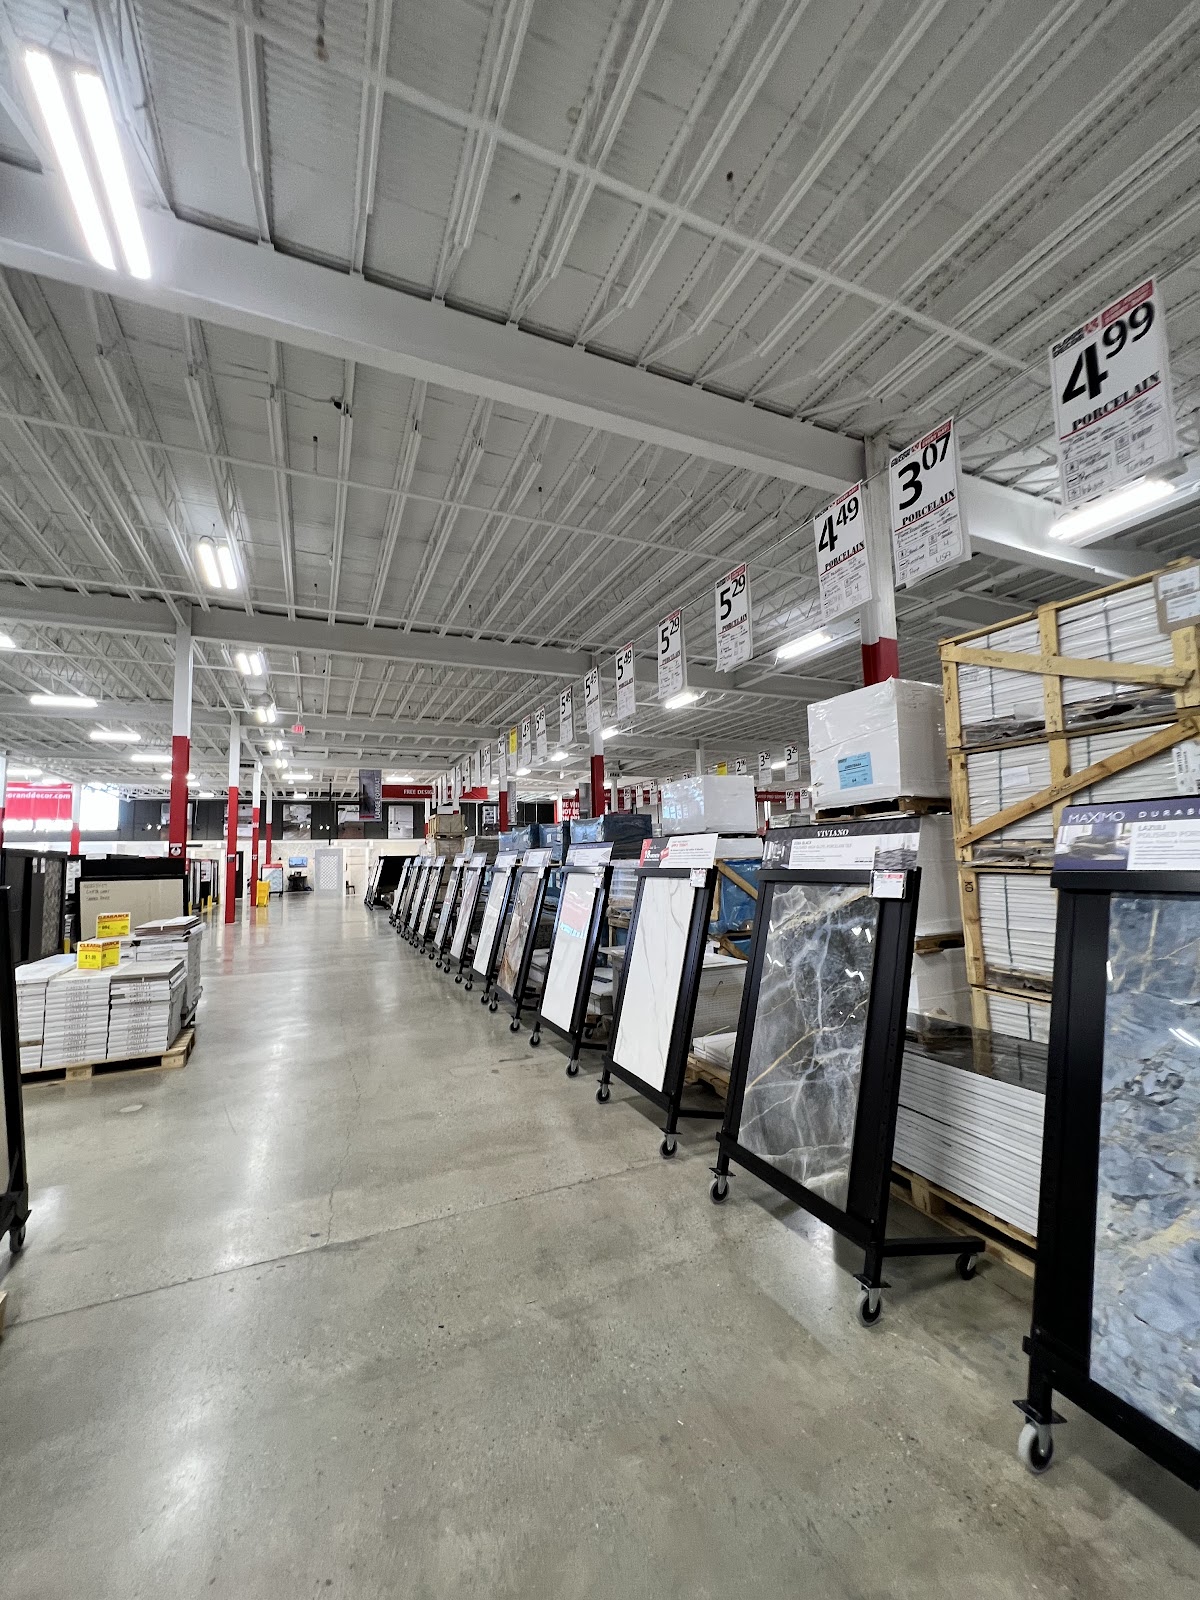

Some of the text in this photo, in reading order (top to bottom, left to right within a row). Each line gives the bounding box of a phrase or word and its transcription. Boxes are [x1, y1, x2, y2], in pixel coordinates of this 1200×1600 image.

[902, 489, 955, 525] PORCELAIN
[825, 540, 866, 570] PORCELAIN
[1068, 811, 1126, 824] MAXIMO
[817, 828, 849, 837] VIVIANO
